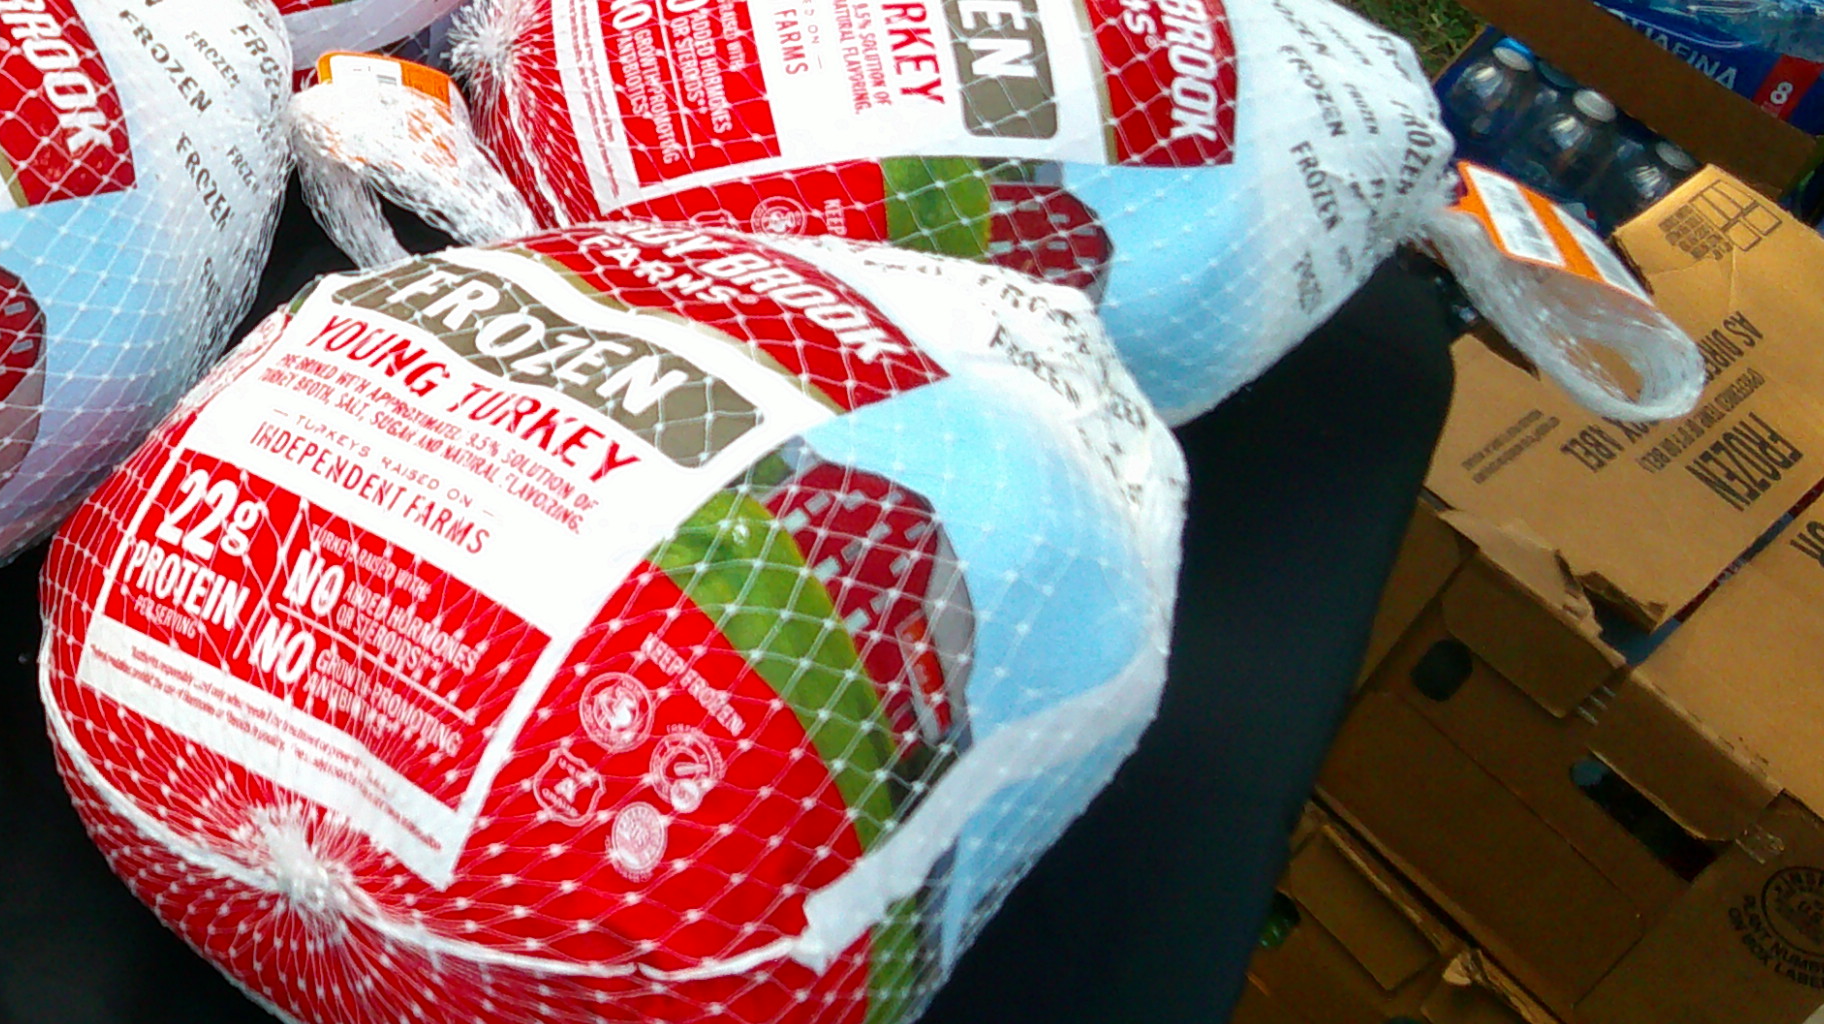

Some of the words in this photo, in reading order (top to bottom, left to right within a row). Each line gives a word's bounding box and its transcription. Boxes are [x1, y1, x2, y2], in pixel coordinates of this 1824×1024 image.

[118, 8, 212, 115] FROZEN
[691, 11, 717, 57] ADDED
[774, 8, 809, 75] FARMS
[699, 55, 733, 134] HORMONES
[1279, 44, 1348, 139] FROZEN
[1769, 81, 1794, 107] 8
[175, 131, 236, 232] FROZEN
[822, 197, 848, 237] KEEP
[1290, 139, 1344, 235] FROZEN
[585, 232, 741, 305] FARMS
[715, 250, 906, 363] BROOK
[388, 266, 692, 416] FROZEN
[1723, 310, 1764, 348] AS
[304, 313, 451, 398] YOUNG
[446, 381, 642, 484] TURKEY
[334, 392, 366, 423] SALT,
[369, 410, 416, 444] SUGAR
[249, 421, 407, 512] INDEPENDENT
[402, 494, 491, 555] FARMS
[295, 414, 372, 458] TURKEYS
[381, 456, 441, 492] RAISED
[446, 487, 474, 508] ON
[500, 448, 577, 499] SOLUTION
[1684, 411, 1804, 512] FROZEN
[156, 467, 267, 562] 22g
[123, 538, 250, 631] PROTEIN
[282, 548, 345, 616] NO
[249, 615, 317, 685] NO
[385, 604, 480, 676] HORMONES
